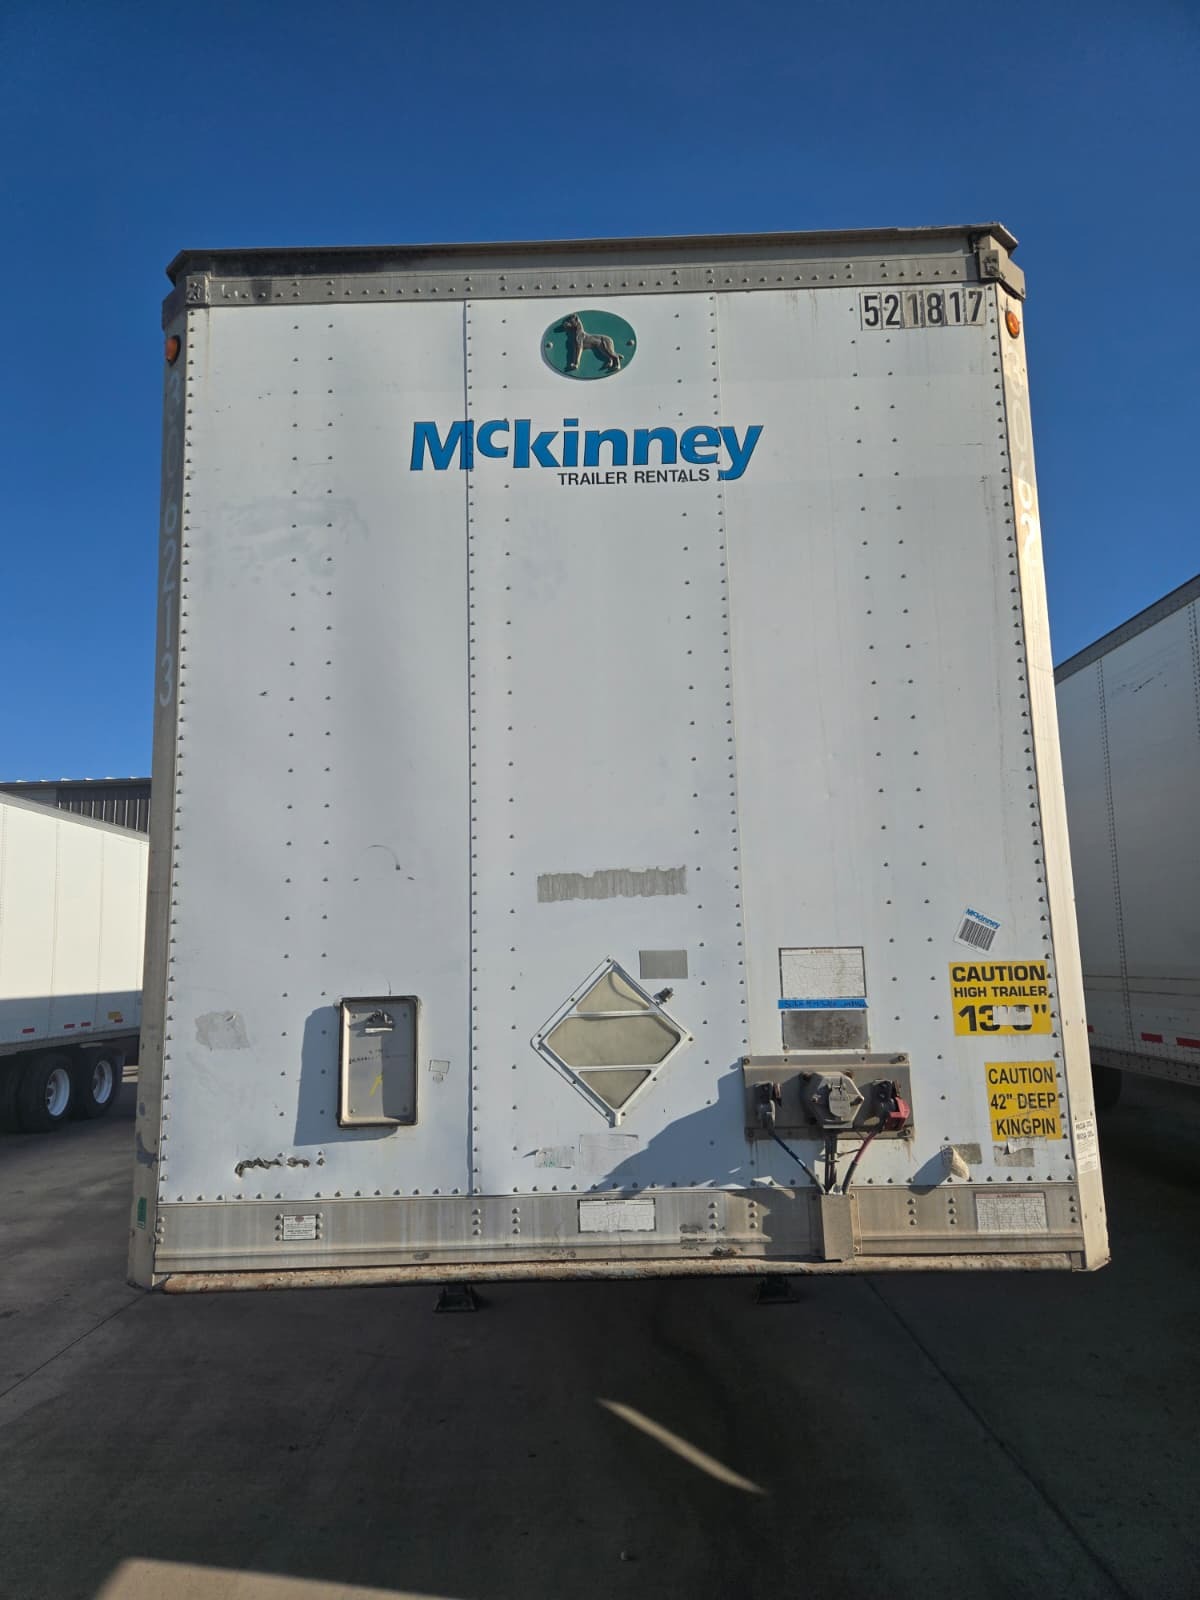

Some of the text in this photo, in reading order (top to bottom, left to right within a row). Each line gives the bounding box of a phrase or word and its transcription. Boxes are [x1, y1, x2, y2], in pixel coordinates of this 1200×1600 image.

[863, 291, 983, 327] 521817
[557, 469, 710, 486] TRAILER RENTALS
[952, 965, 1046, 982] CAUTION
[953, 985, 1047, 998] HIGH TRAILER
[988, 1067, 1054, 1085] CAUTION
[990, 1092, 1056, 1110] 42" DEEP
[996, 1117, 1056, 1135] KINGPIN
